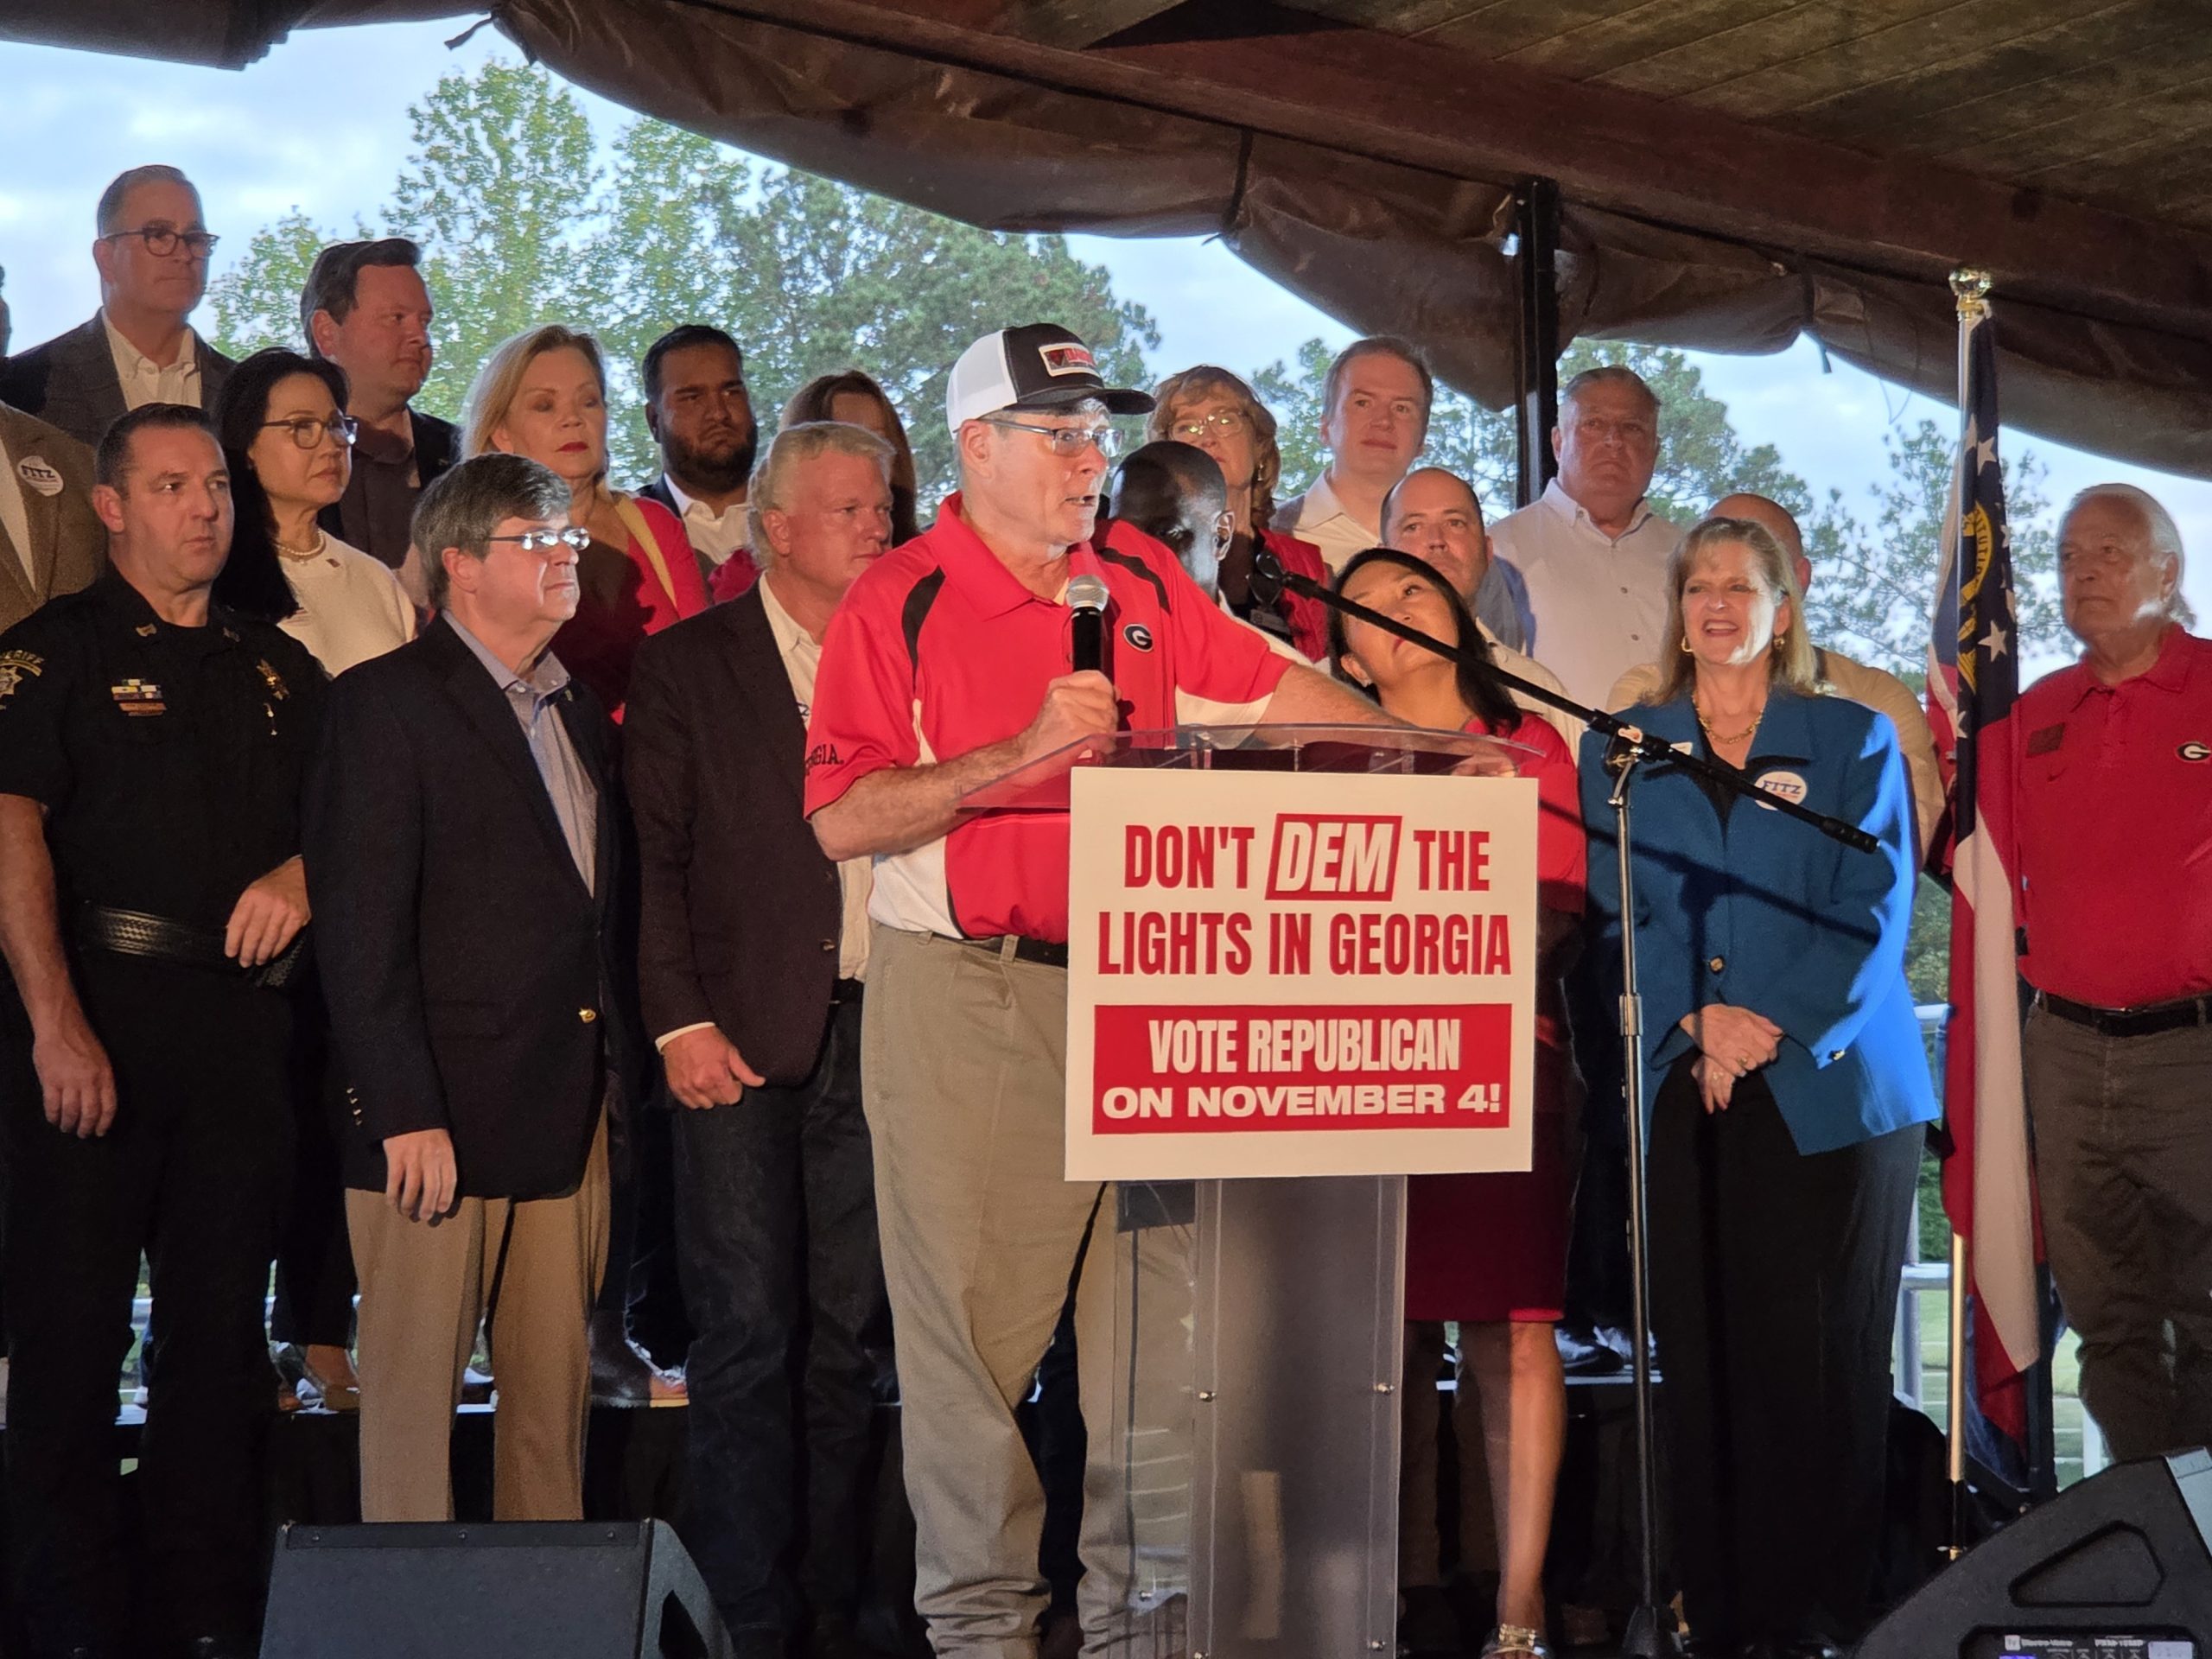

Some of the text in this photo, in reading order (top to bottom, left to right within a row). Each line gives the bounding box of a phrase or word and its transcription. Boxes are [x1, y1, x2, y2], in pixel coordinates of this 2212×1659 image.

[1763, 779, 1801, 794] FITZ
[1124, 821, 1491, 893] DON'T DEM THE
[1097, 911, 1512, 976] LIGHTS IN GEORGIA
[1147, 1018, 1461, 1073] VOTE REPUBLICAN
[1102, 1083, 1502, 1119] ON NOVEMBER 4!
